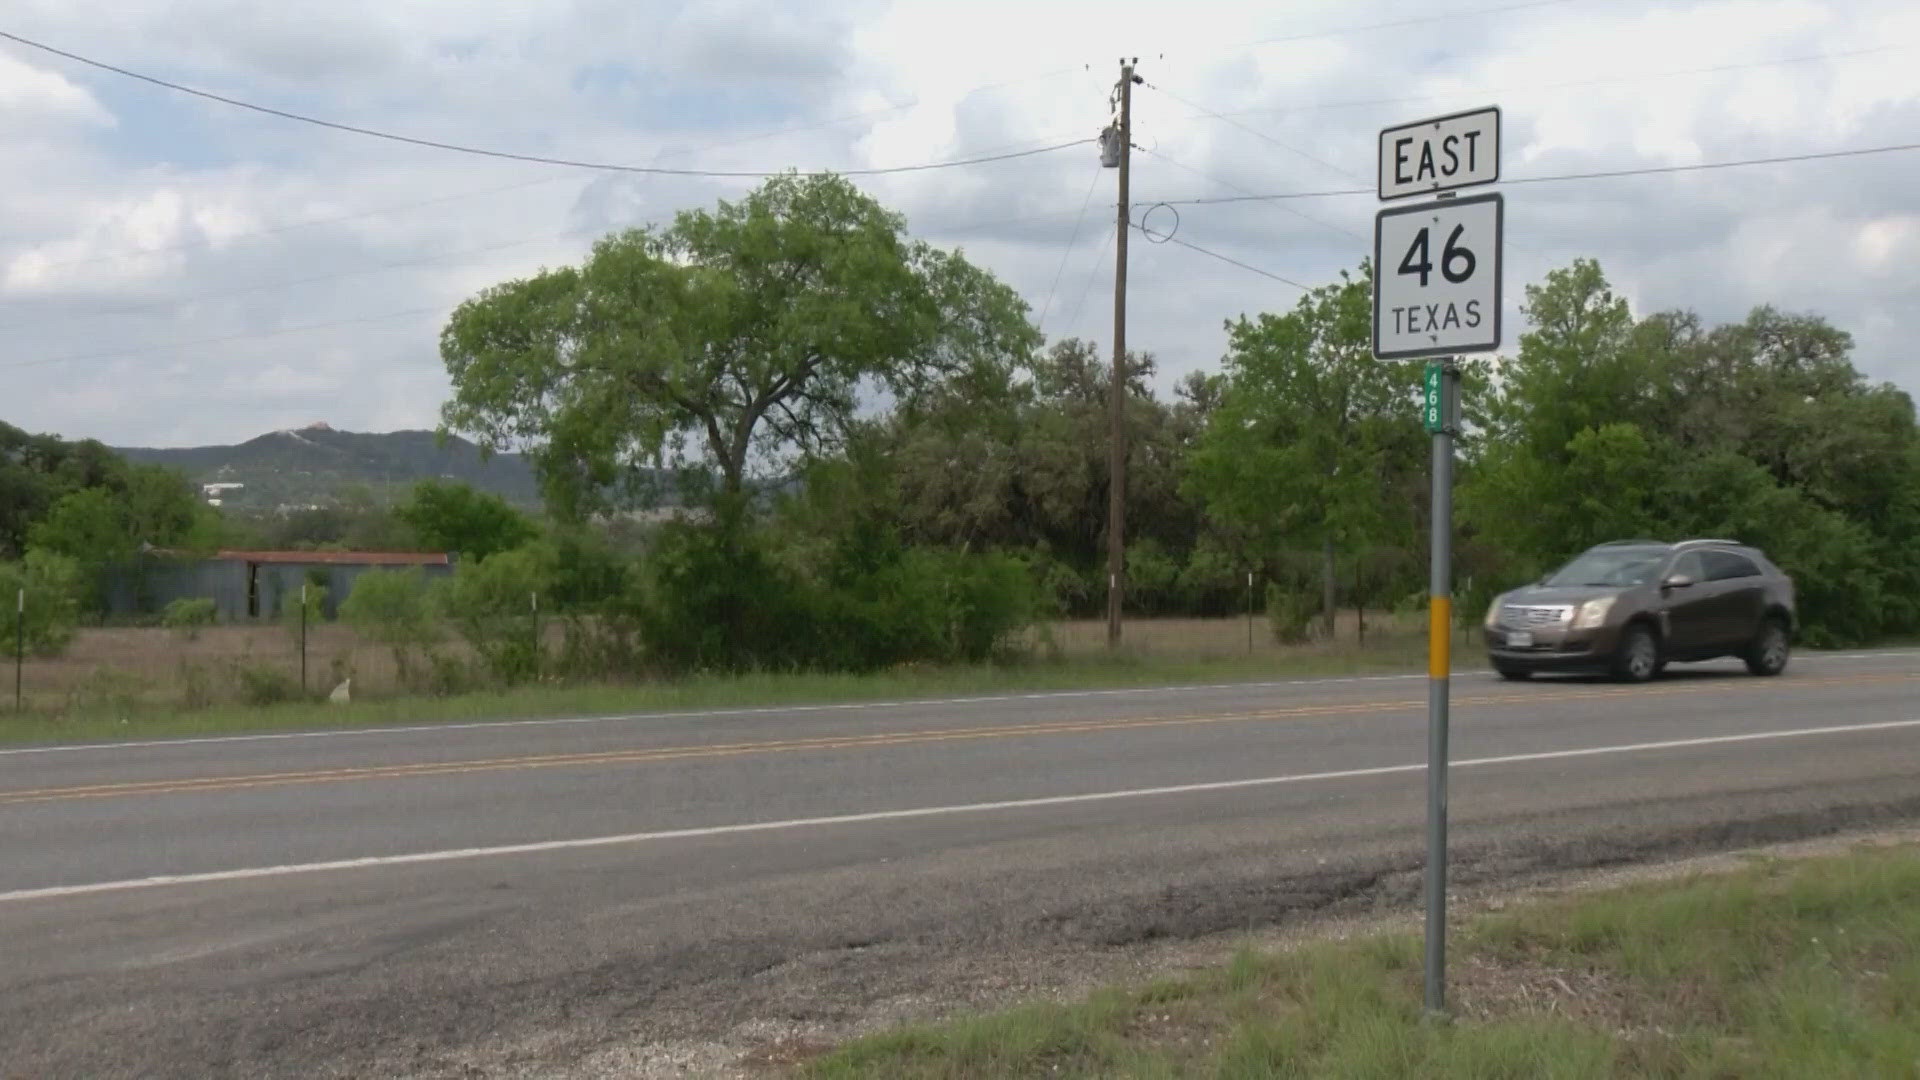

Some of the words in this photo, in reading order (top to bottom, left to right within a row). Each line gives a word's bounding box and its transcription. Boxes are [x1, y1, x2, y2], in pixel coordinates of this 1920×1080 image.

[1395, 131, 1481, 185] EAST
[1397, 223, 1476, 287] 46
[1391, 299, 1481, 334] TEXAS
[1428, 372, 1439, 423] 468
